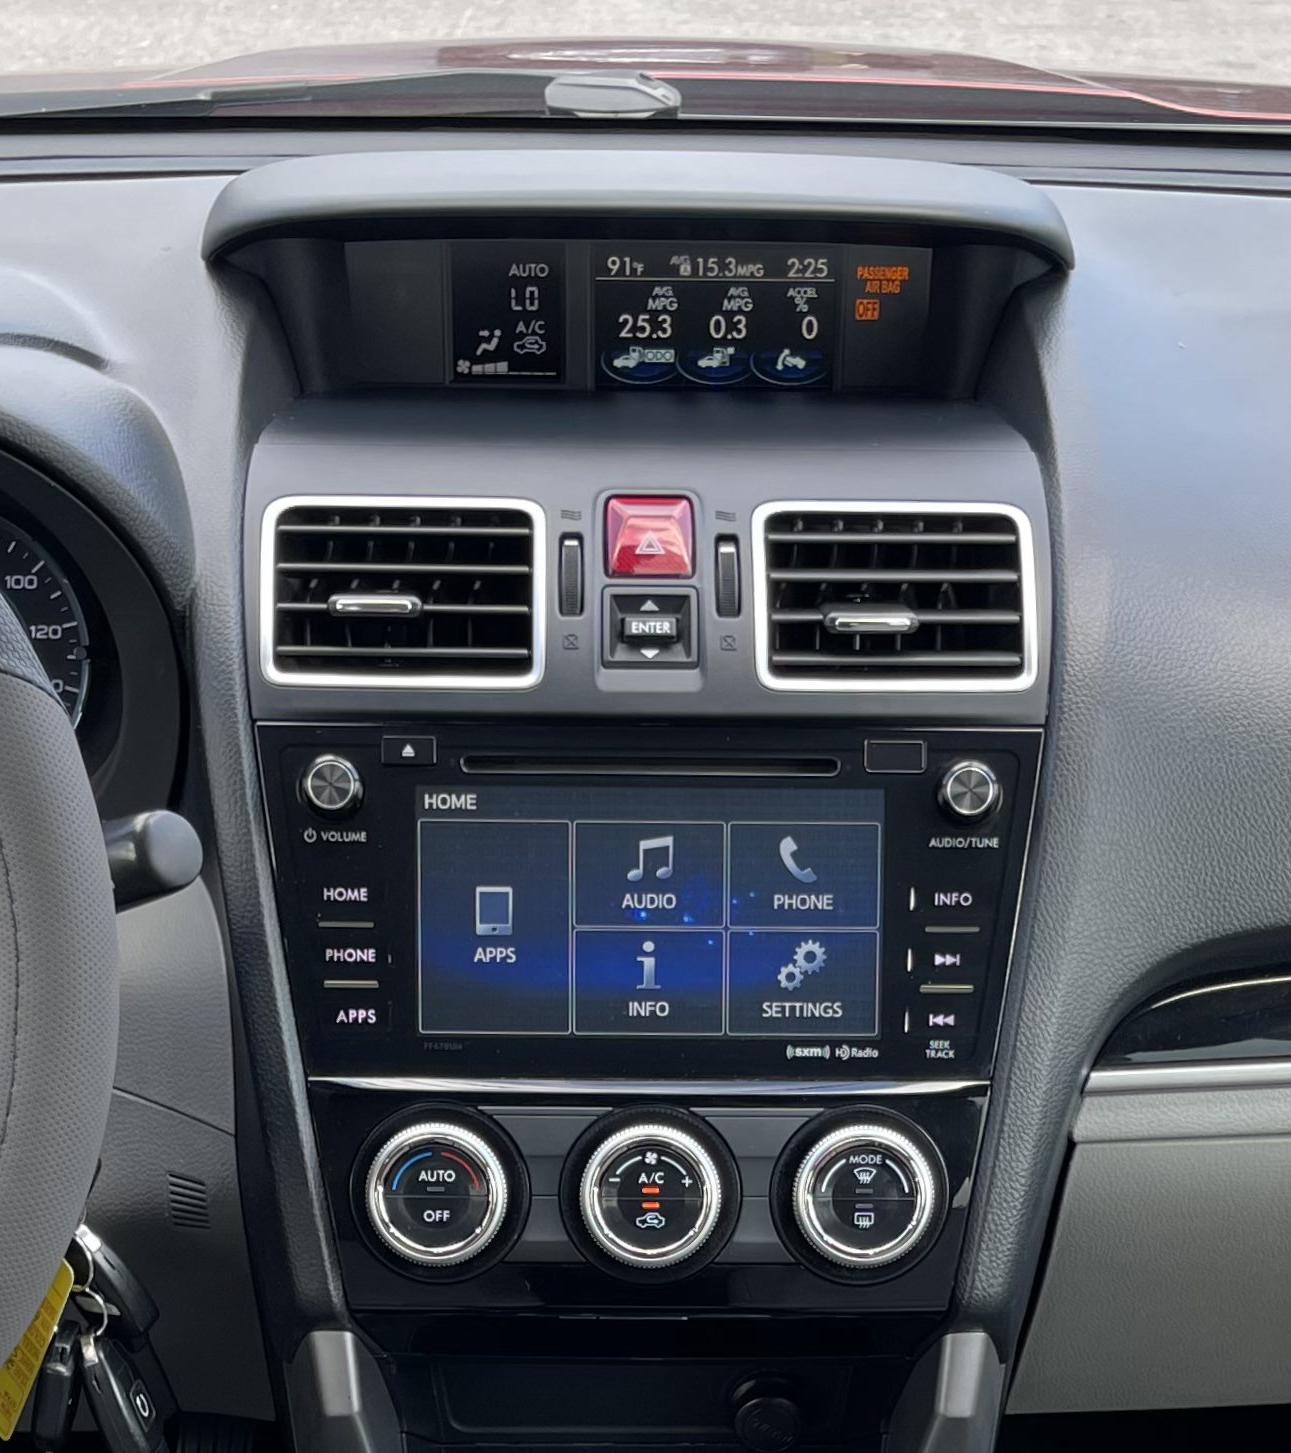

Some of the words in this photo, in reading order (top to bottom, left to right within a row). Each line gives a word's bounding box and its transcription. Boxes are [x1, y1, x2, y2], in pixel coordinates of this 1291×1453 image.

[508, 263, 549, 277] AUTO
[787, 257, 829, 278] 2:25
[856, 266, 909, 280] PASSENGER
[864, 281, 880, 293] AIR
[881, 281, 901, 294] BAG
[511, 286, 539, 311] LO
[646, 298, 679, 311] MPG
[722, 298, 754, 312] MPG
[857, 301, 880, 318] OFF
[515, 319, 546, 334] A/C
[618, 314, 673, 339] 25.3
[709, 314, 748, 340] 0.3
[801, 315, 819, 340] 0
[4, 575, 38, 589] 100
[29, 625, 62, 639] 120
[631, 621, 671, 634] ENTER
[423, 794, 477, 810] HOME
[321, 831, 367, 842] VOLUME
[928, 836, 999, 849] AUDIO/TUNE
[323, 887, 368, 901] HOME
[621, 893, 677, 909] AUDIO
[934, 893, 973, 907] INFO
[773, 895, 834, 910] PHONE
[325, 948, 376, 962] PHONE
[473, 948, 516, 963] APPS
[336, 1009, 377, 1023] APPS
[628, 1001, 670, 1017] INFO
[761, 1002, 843, 1017] SETTINGS
[929, 1040, 950, 1049] SEEK
[851, 1048, 879, 1058] Radio
[925, 1050, 955, 1059] TRACK
[848, 1154, 883, 1166] MODE
[418, 1170, 456, 1183] AUTO
[638, 1172, 664, 1185] A/C
[423, 1209, 450, 1223] OFF
